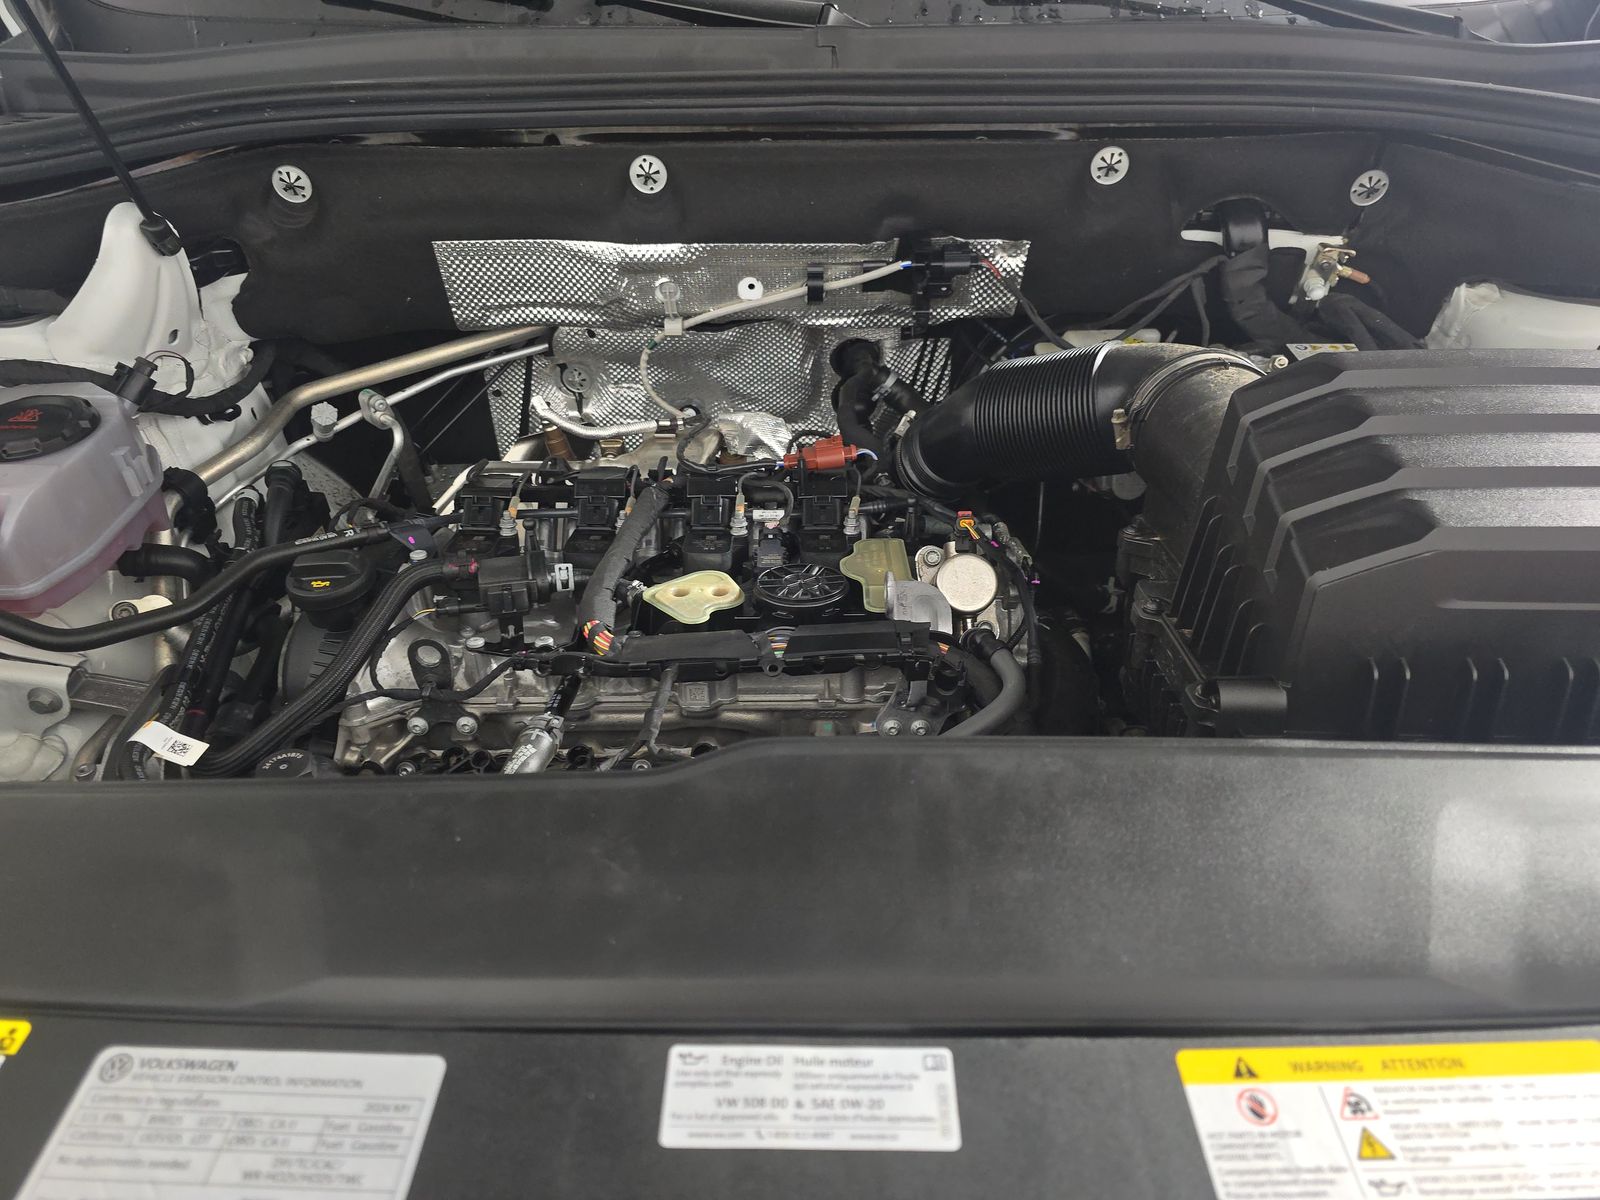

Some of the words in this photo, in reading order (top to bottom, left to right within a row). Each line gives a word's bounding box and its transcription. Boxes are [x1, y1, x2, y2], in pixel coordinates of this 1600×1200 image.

[138, 1056, 239, 1072] VOLKSWAGEN
[722, 1054, 761, 1069] Engine
[765, 1054, 784, 1067] Oil
[793, 1055, 825, 1068] Huile
[829, 1056, 874, 1068] moteur
[1289, 1059, 1364, 1074] WARNING
[1381, 1057, 1466, 1072] ATTENTION
